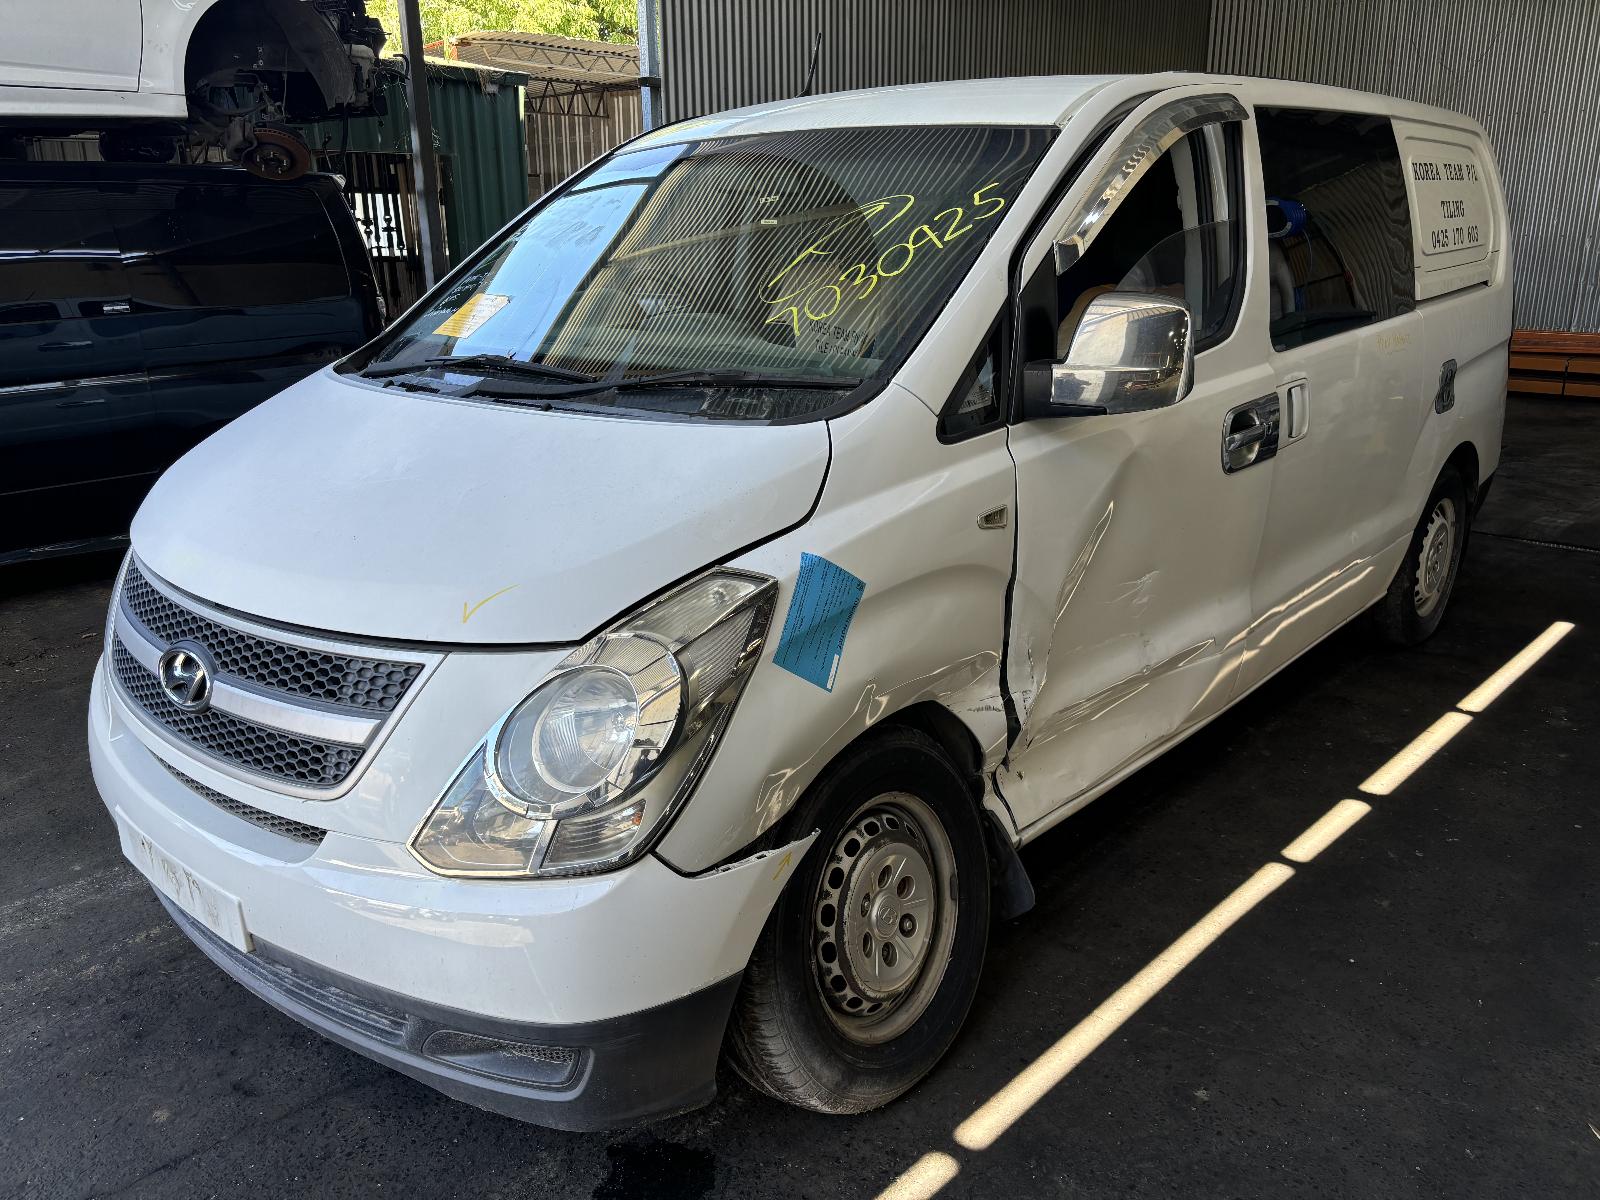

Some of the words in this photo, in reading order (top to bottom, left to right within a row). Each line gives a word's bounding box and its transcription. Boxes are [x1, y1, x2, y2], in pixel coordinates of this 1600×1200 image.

[1412, 162, 1442, 181] KOREA
[1443, 163, 1465, 181] TEAM
[1440, 200, 1465, 219] TILING
[1431, 228, 1450, 250] 0425
[1452, 226, 1464, 246] 170
